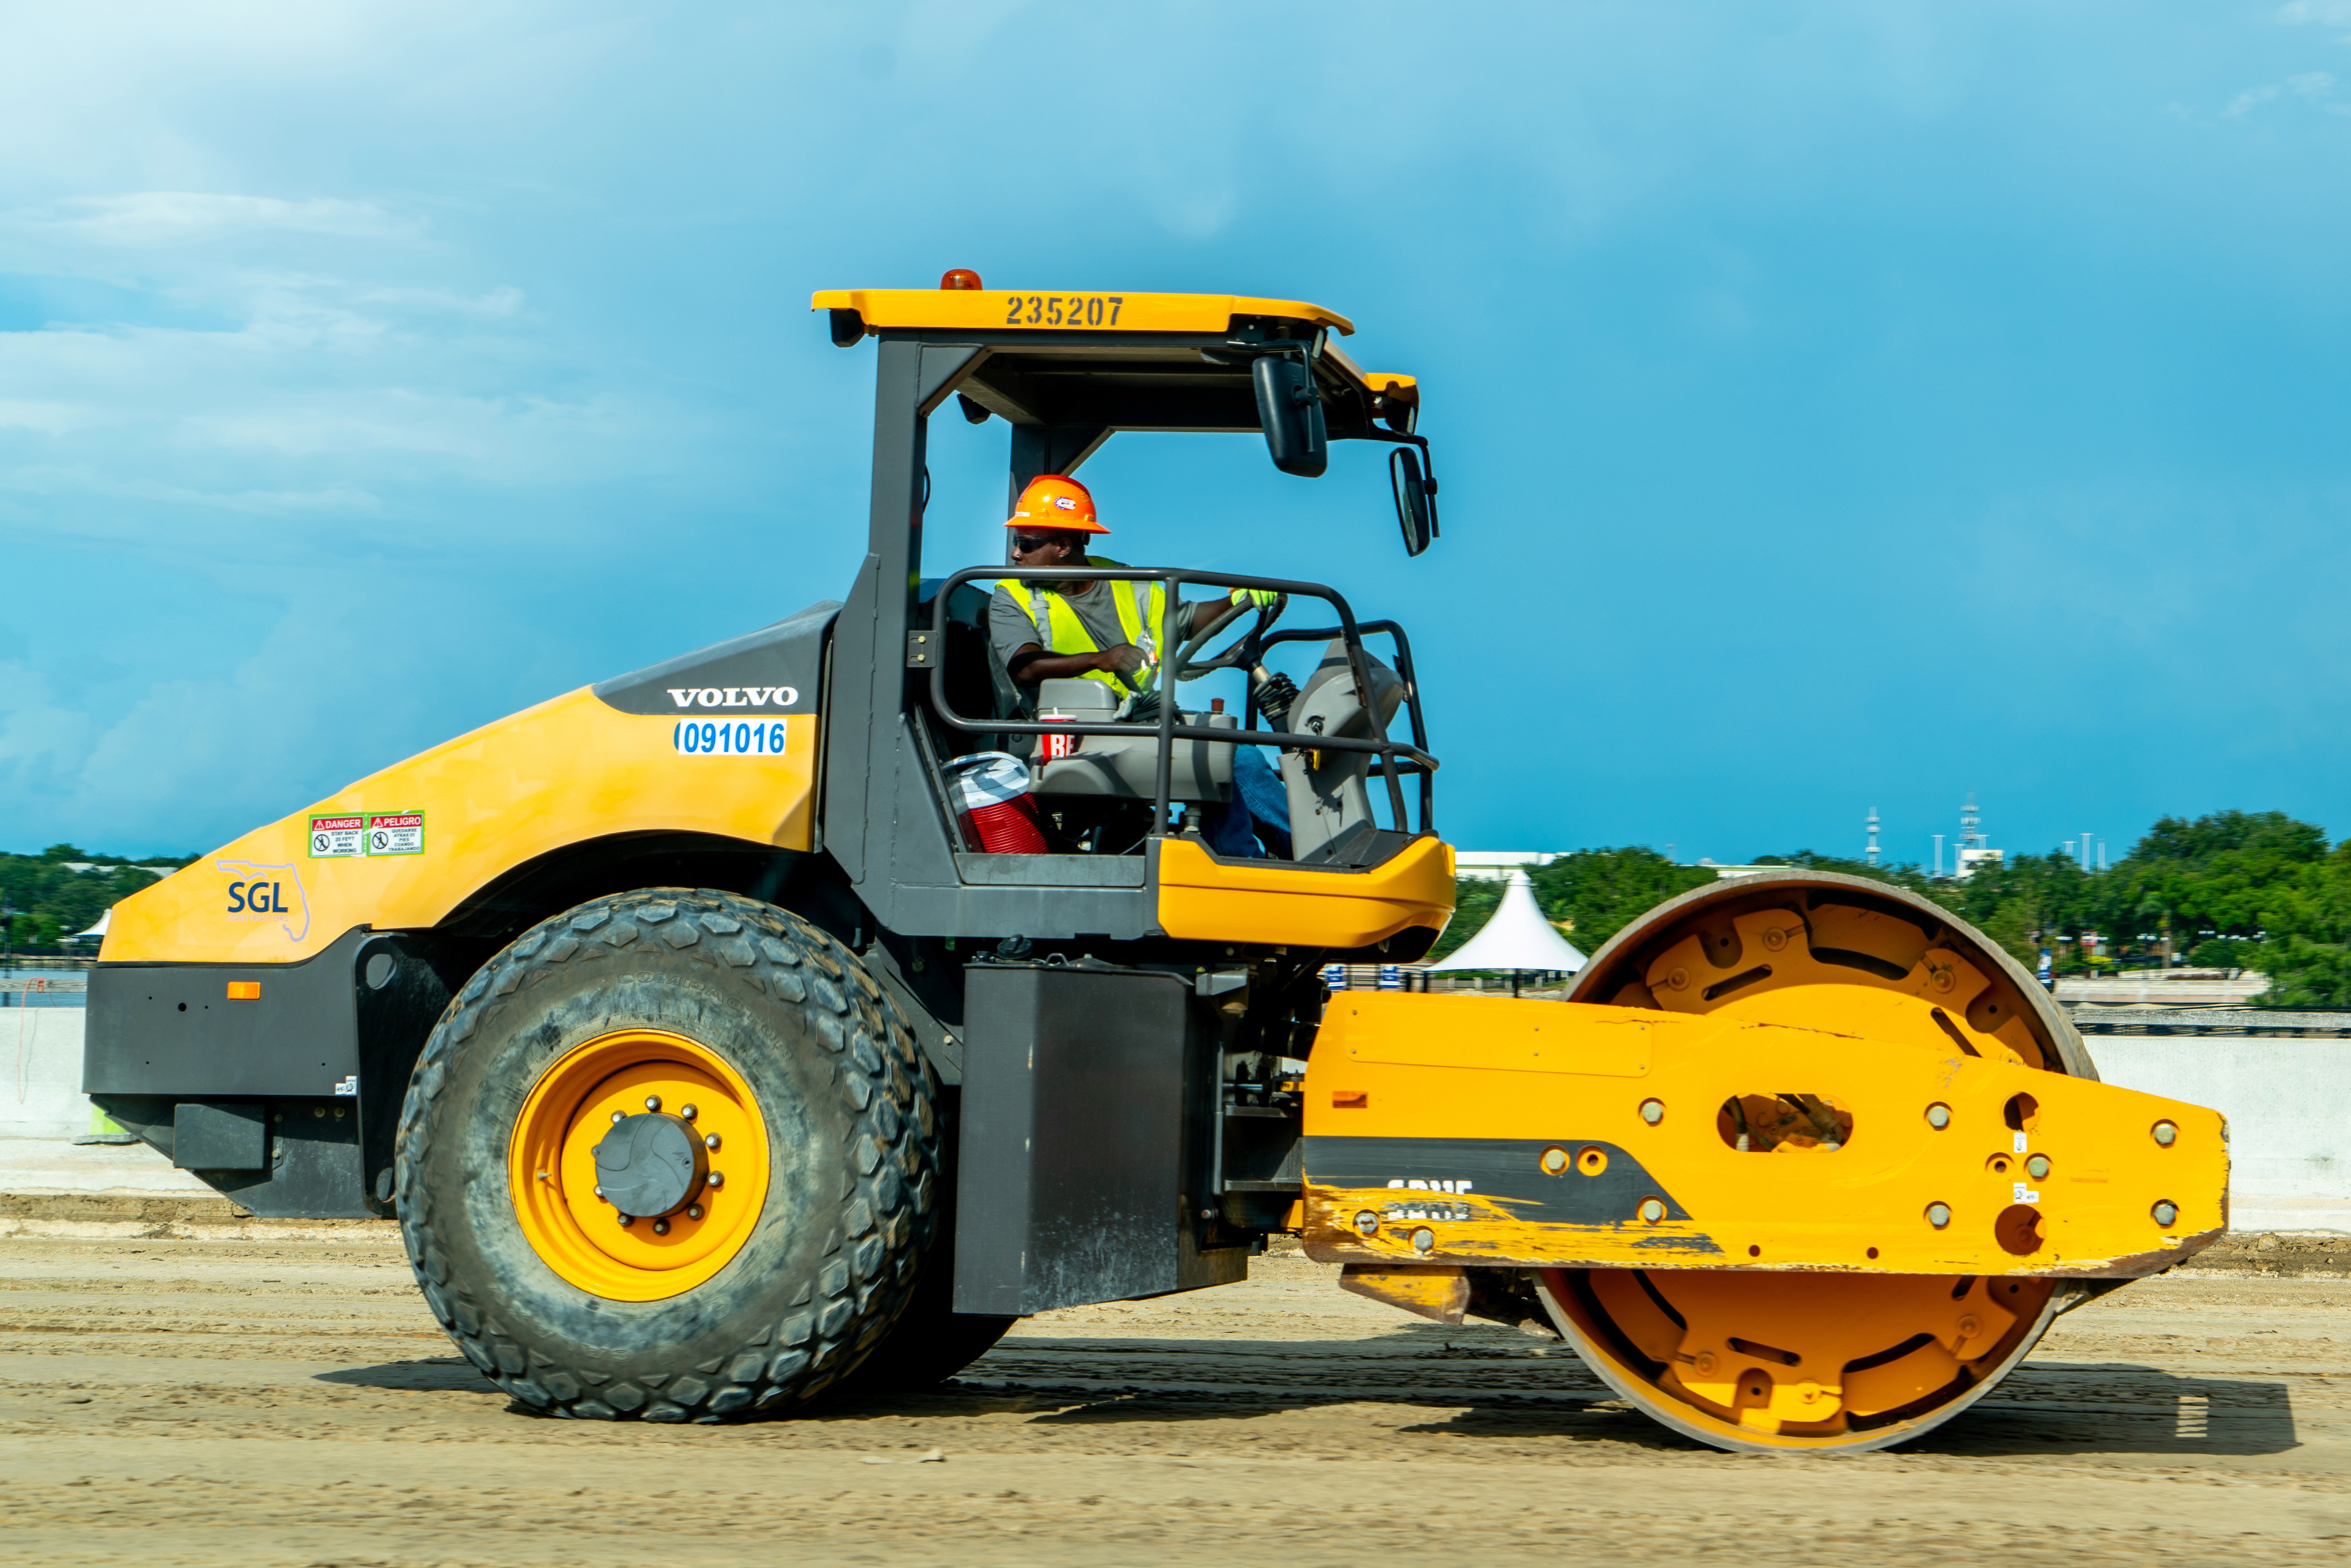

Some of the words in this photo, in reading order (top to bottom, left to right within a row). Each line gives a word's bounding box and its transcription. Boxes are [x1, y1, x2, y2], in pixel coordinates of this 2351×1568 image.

[1006, 296, 1123, 325] 235207
[667, 687, 799, 707] VOLVO
[684, 723, 785, 753] 091016
[325, 819, 361, 829] DANGER
[384, 816, 421, 826] PELIGRO
[227, 881, 288, 913] SGL
[617, 971, 793, 1062] COMPACTOR
